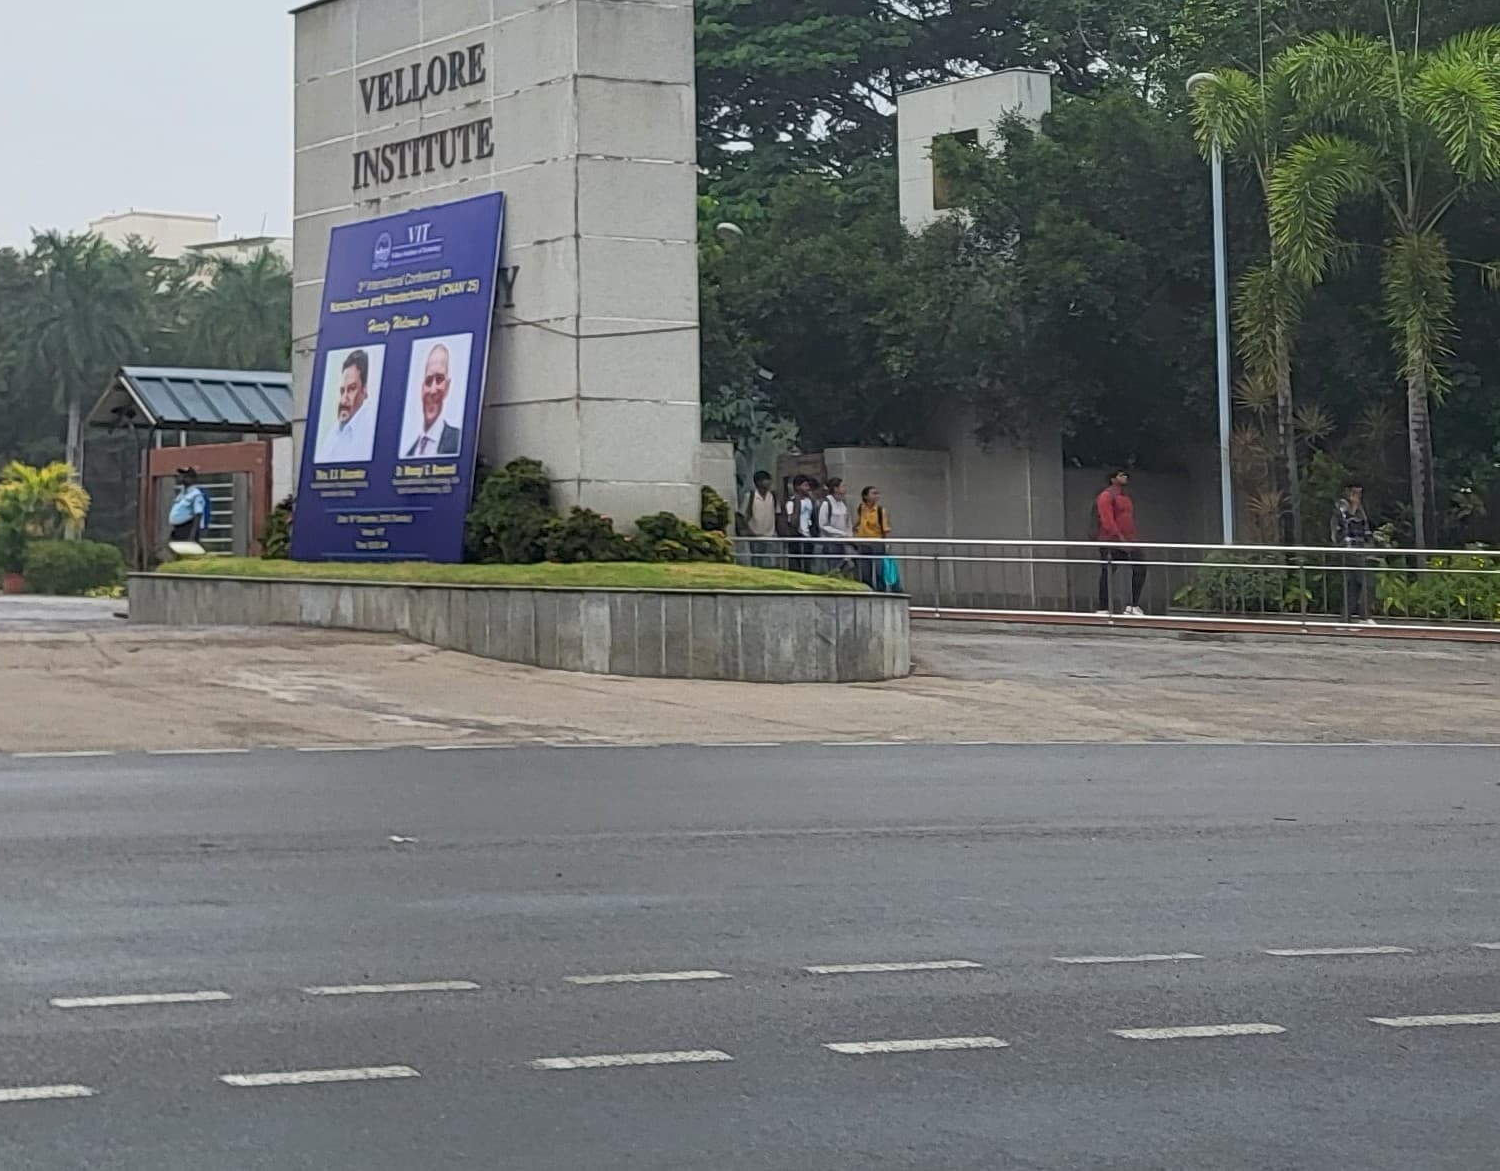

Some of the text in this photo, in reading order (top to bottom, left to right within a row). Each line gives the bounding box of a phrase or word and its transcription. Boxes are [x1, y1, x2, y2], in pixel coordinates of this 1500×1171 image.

[358, 42, 486, 115] VELLORE
[352, 117, 495, 190] INSTITUTE
[407, 223, 432, 243] VIT
